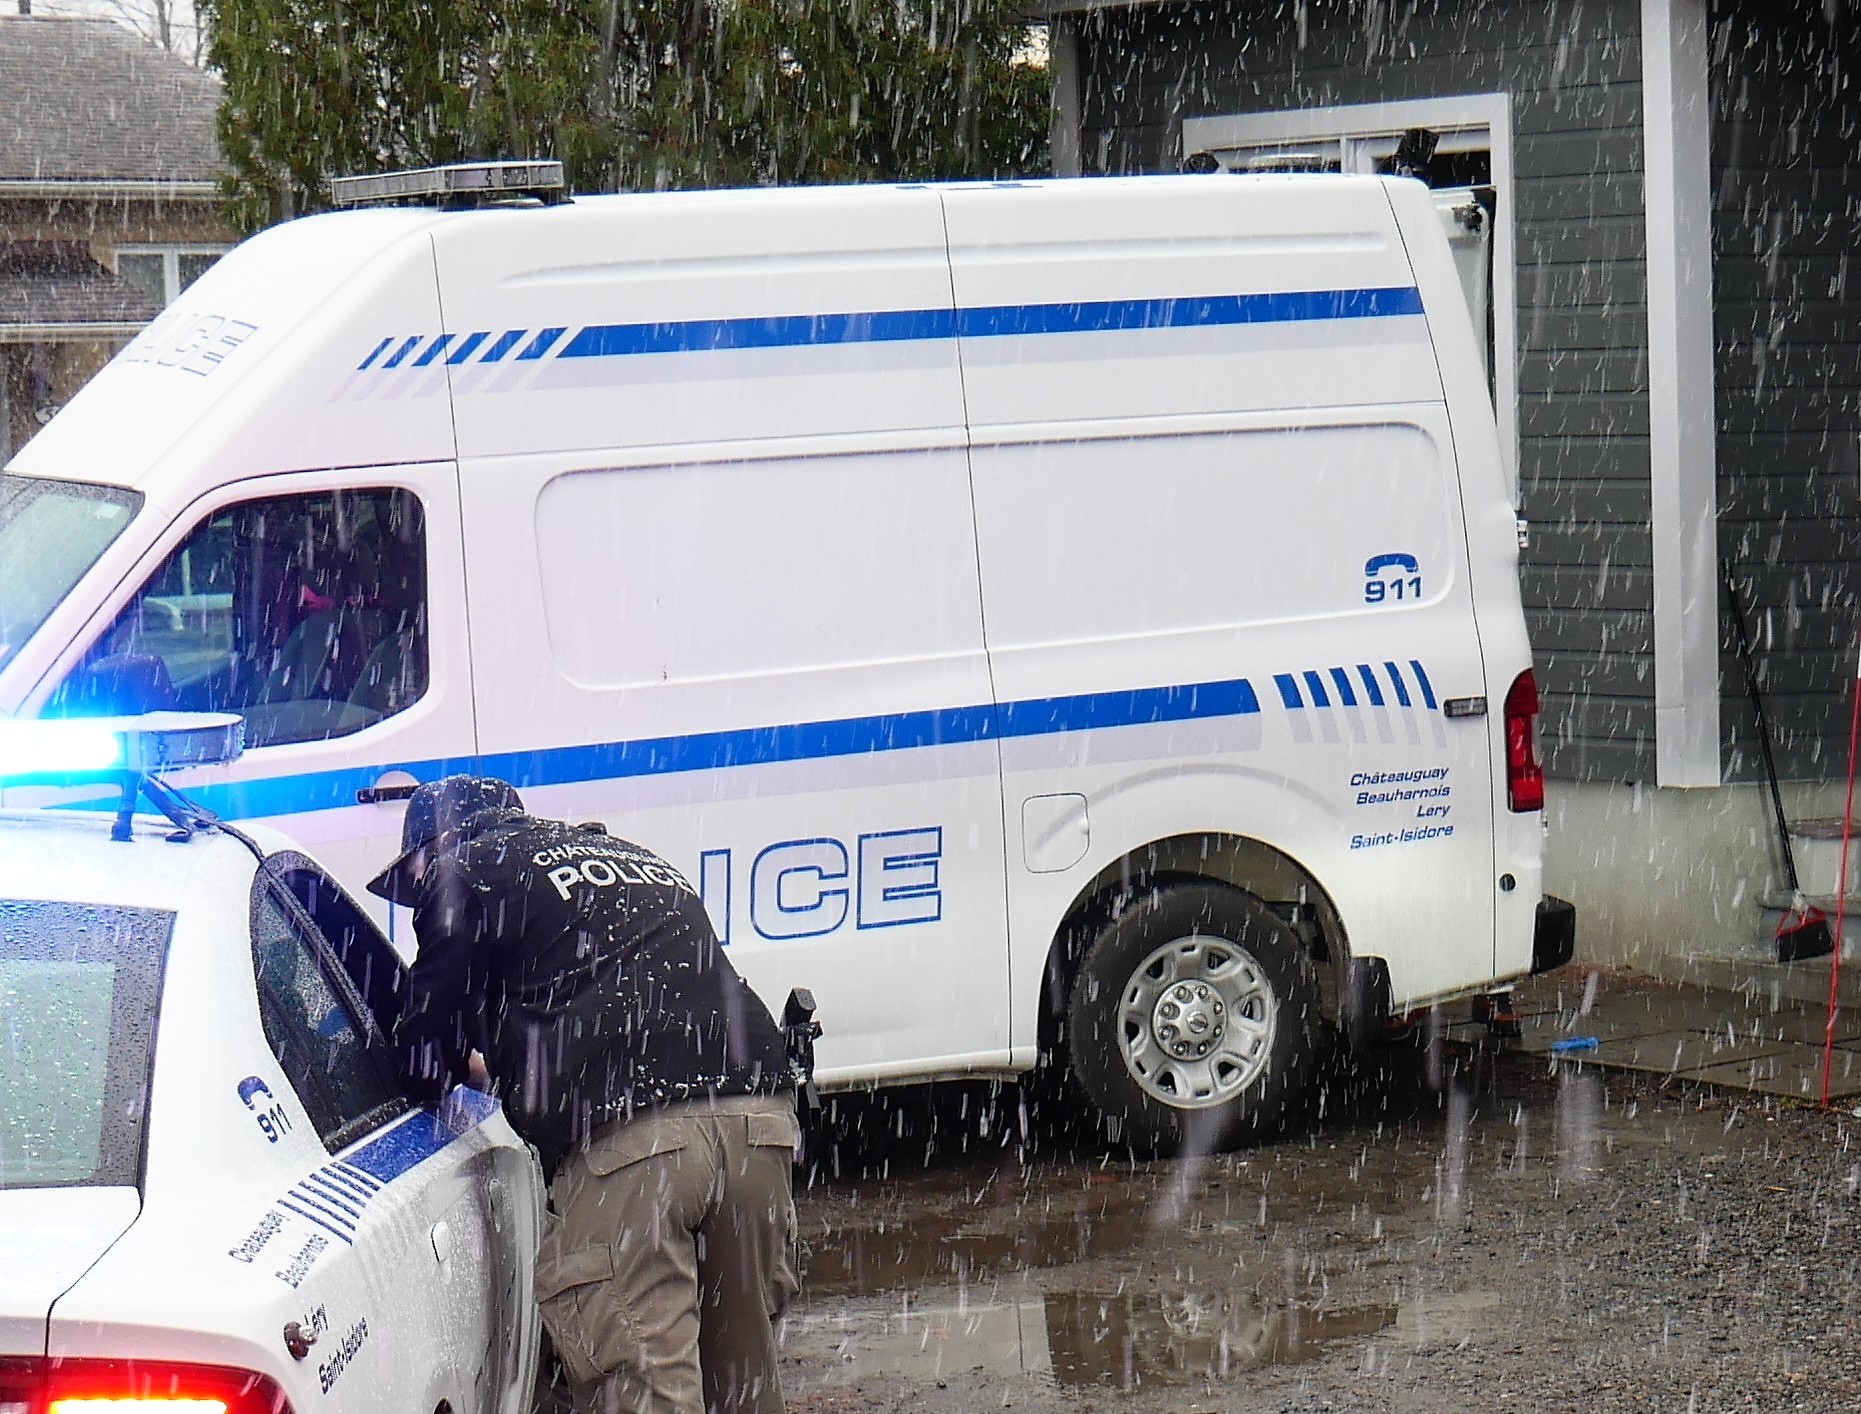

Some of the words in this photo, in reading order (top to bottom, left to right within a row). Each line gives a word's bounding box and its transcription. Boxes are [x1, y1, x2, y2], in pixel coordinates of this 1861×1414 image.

[1364, 576, 1422, 603] 911
[1356, 784, 1451, 804] Beauharnois
[1350, 825, 1454, 849] Saint-Isidore
[547, 859, 697, 901] POLICE
[700, 826, 942, 946] ICE
[257, 1103, 293, 1144] 911
[318, 1316, 369, 1395] Saint-Isidore
